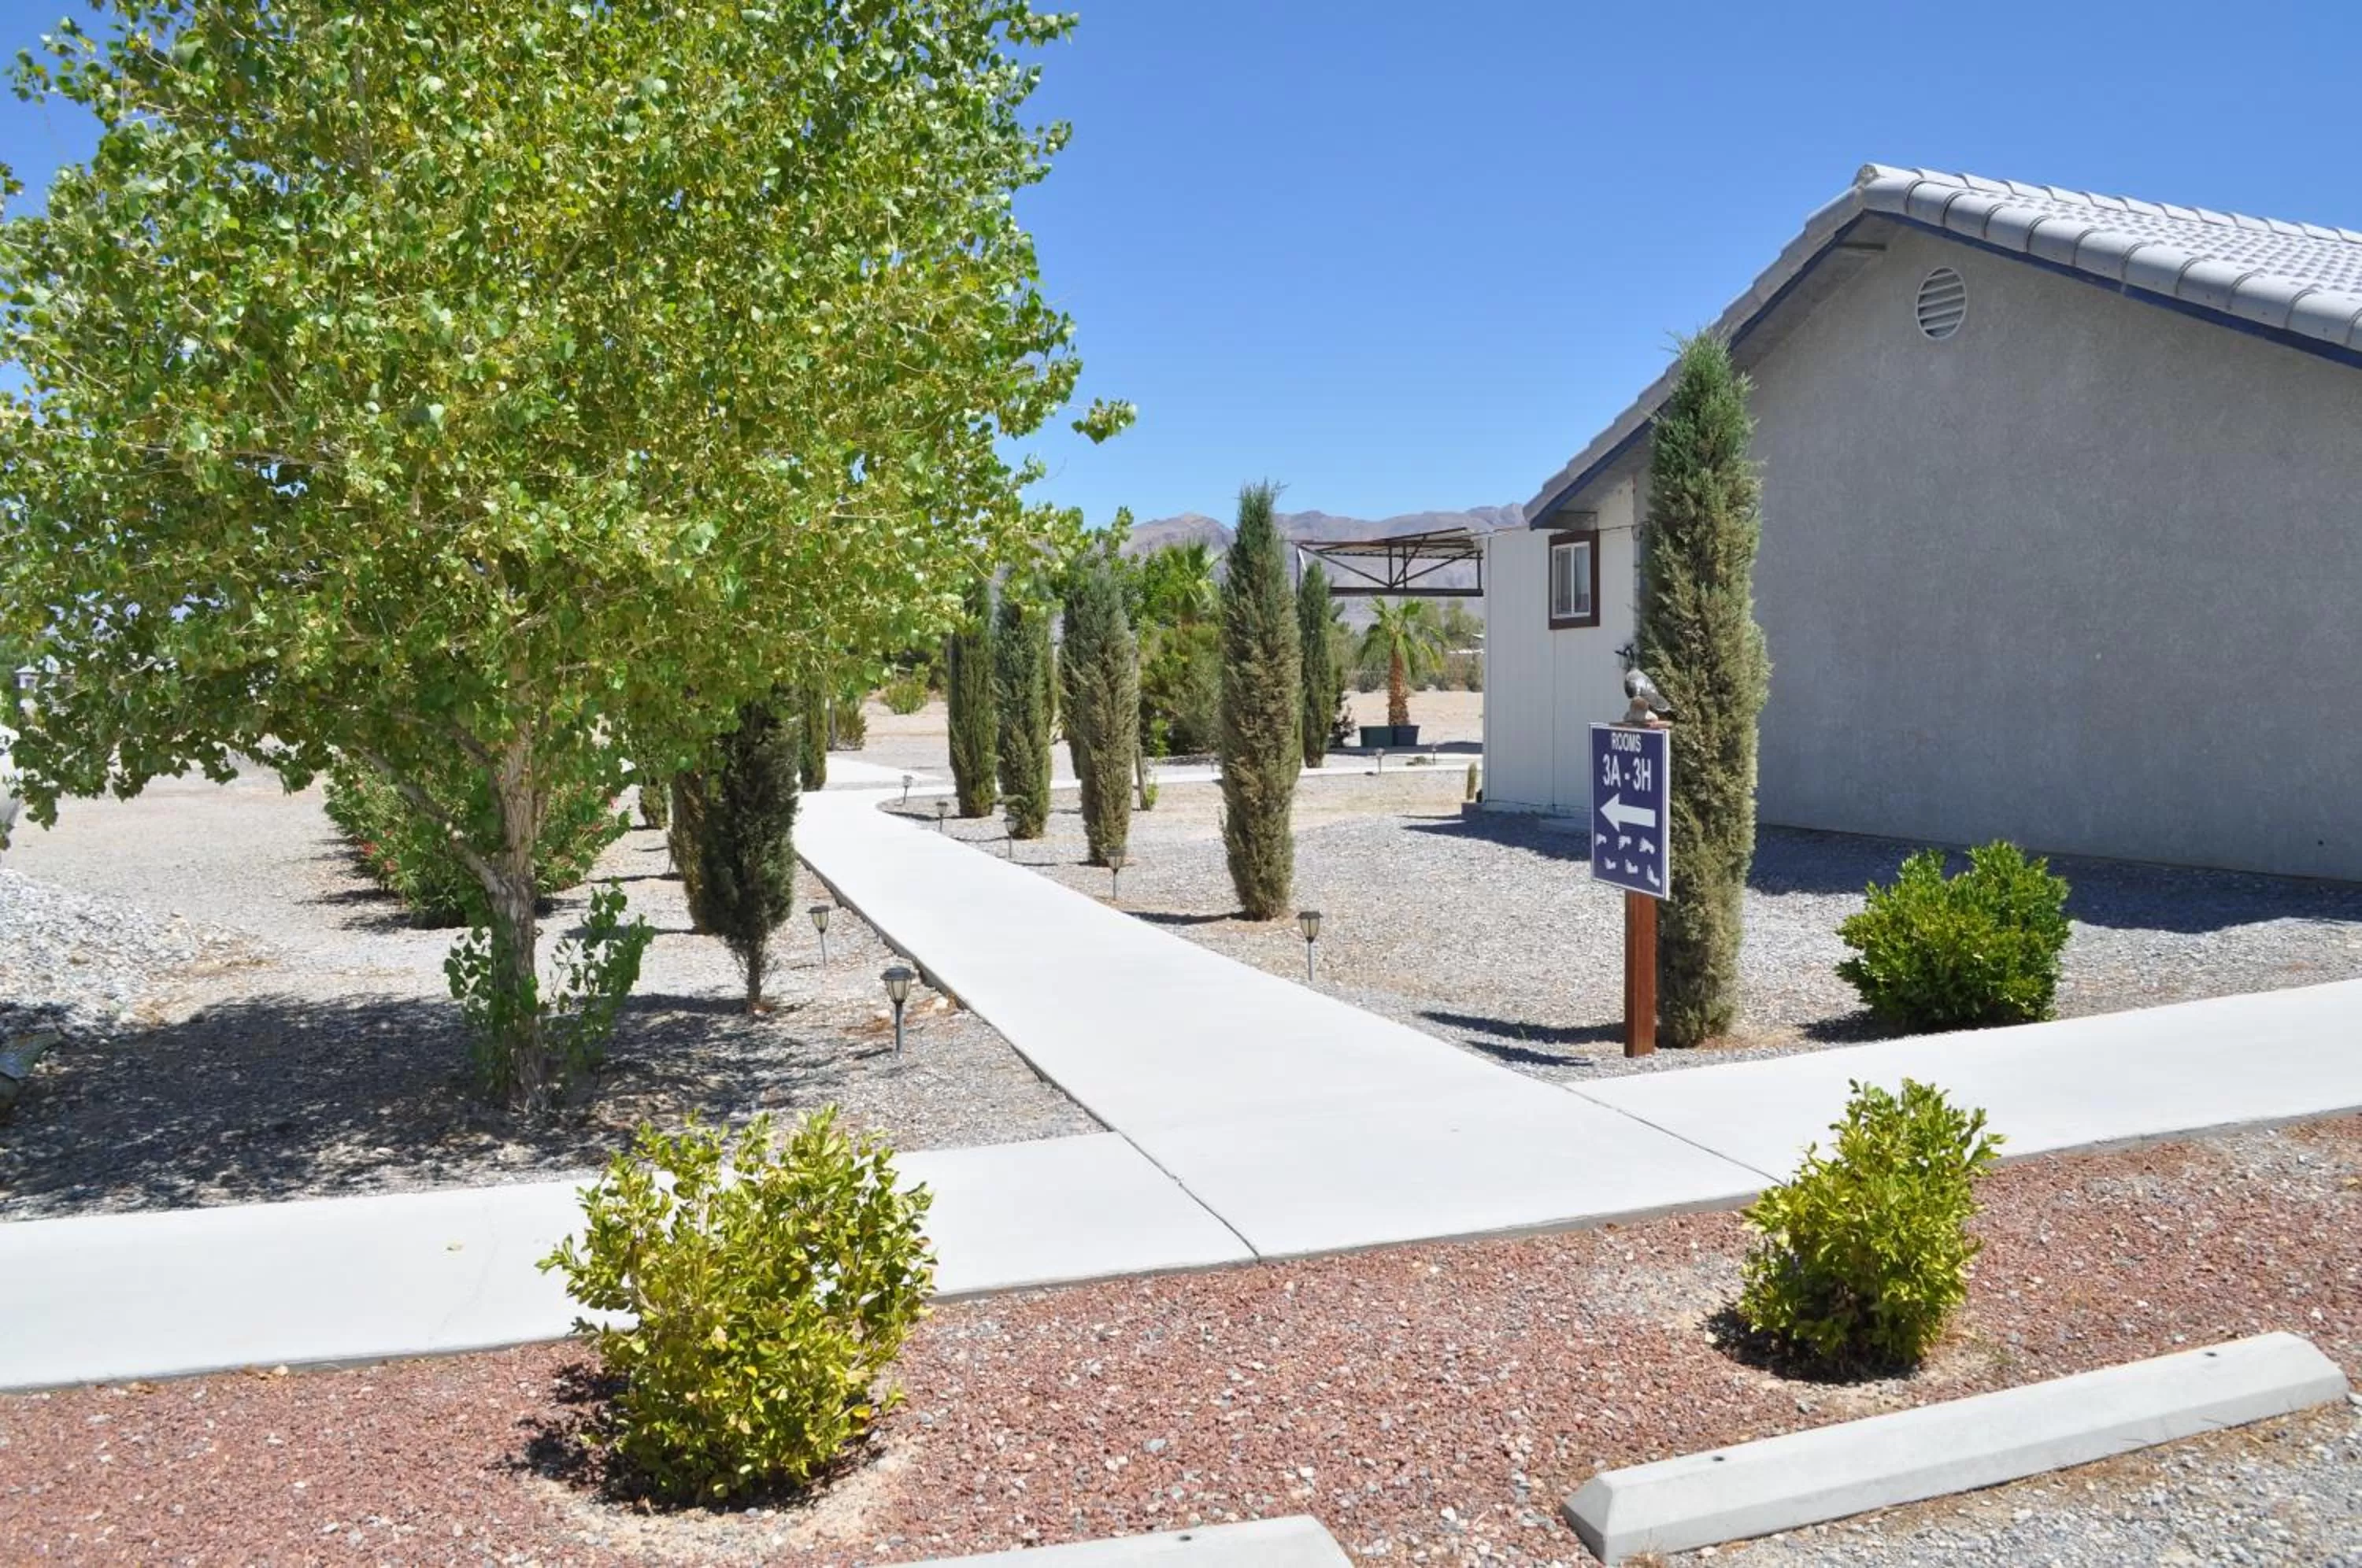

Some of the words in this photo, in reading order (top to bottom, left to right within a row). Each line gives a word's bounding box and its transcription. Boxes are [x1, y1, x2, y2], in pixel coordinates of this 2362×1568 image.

[1612, 732, 1642, 753] ROOMS
[1602, 753, 1621, 788] 3A
[1633, 757, 1651, 792] 3H
